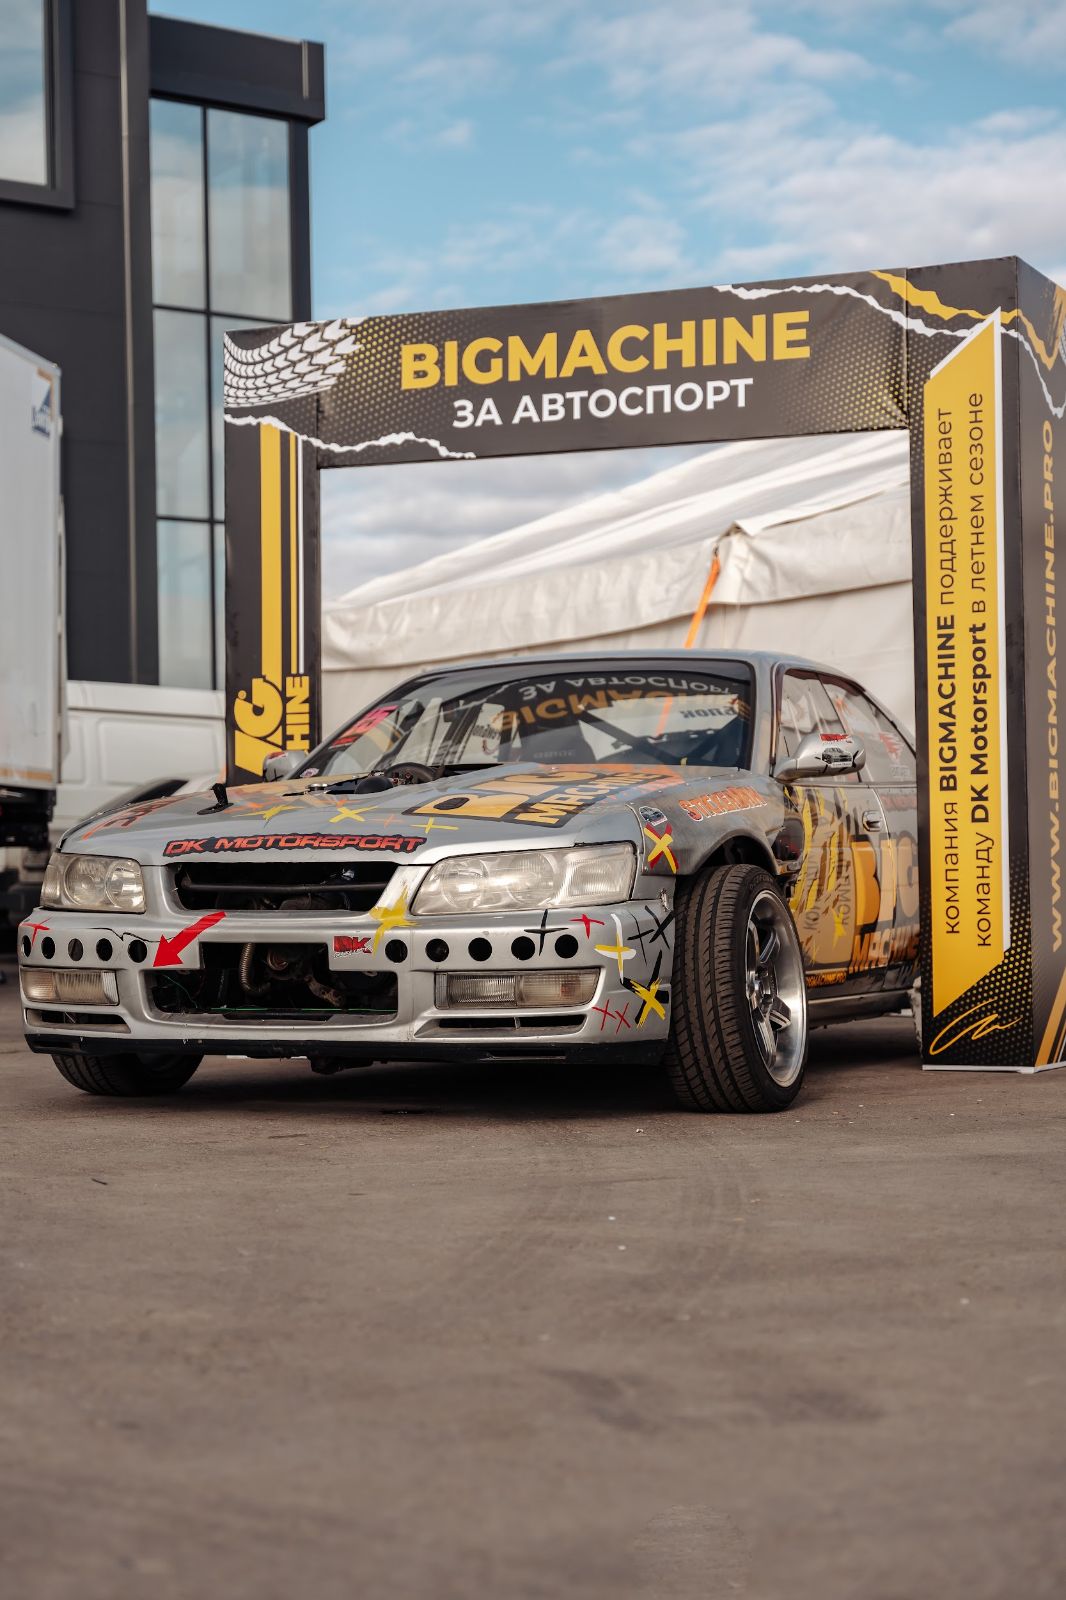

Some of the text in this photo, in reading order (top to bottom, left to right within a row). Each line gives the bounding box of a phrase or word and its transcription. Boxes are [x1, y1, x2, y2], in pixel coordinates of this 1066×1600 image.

[400, 310, 811, 391] BIGMACHINE
[452, 377, 754, 428] ЗА АВТОСПОРТ
[936, 407, 960, 935] компания BIGMACHINE поддерживает
[968, 392, 995, 947] команду DK Motorsport в летнем сезоне
[1042, 419, 1064, 954] WWW.BIGMACHINE.PRO
[412, 771, 599, 818] BIG
[166, 834, 424, 856] DK MOTORSPORT
[851, 832, 919, 926] BIG
